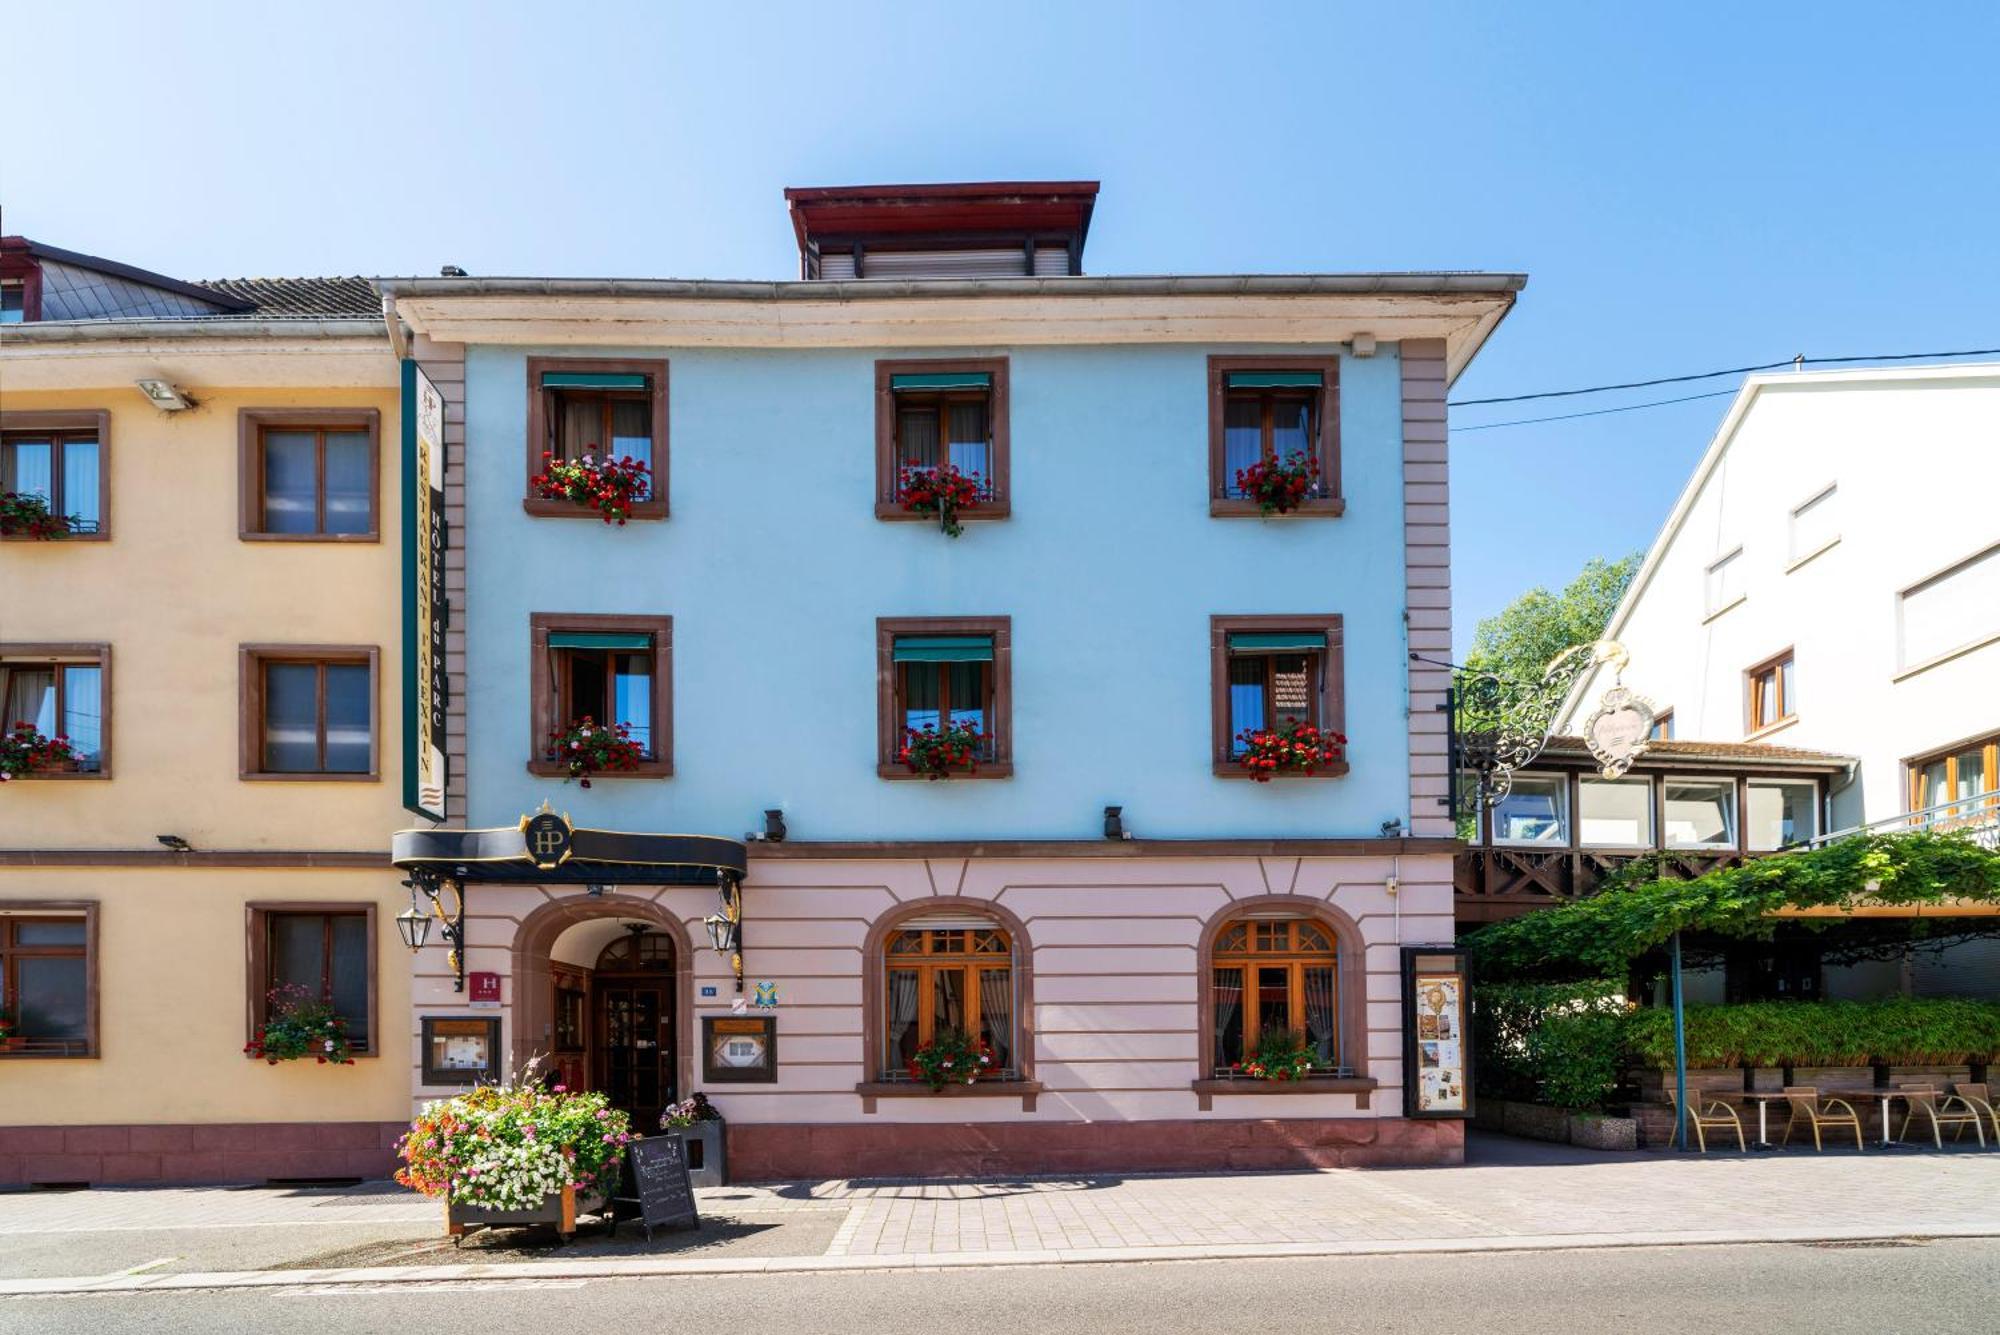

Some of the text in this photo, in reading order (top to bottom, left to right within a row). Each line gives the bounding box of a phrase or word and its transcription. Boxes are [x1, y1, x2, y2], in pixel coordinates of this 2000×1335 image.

[419, 444, 428, 620] RESTAURANT
[433, 617, 441, 645] du
[432, 654, 442, 727] PARC
[534, 831, 564, 854] HP
[483, 976, 497, 989] H
